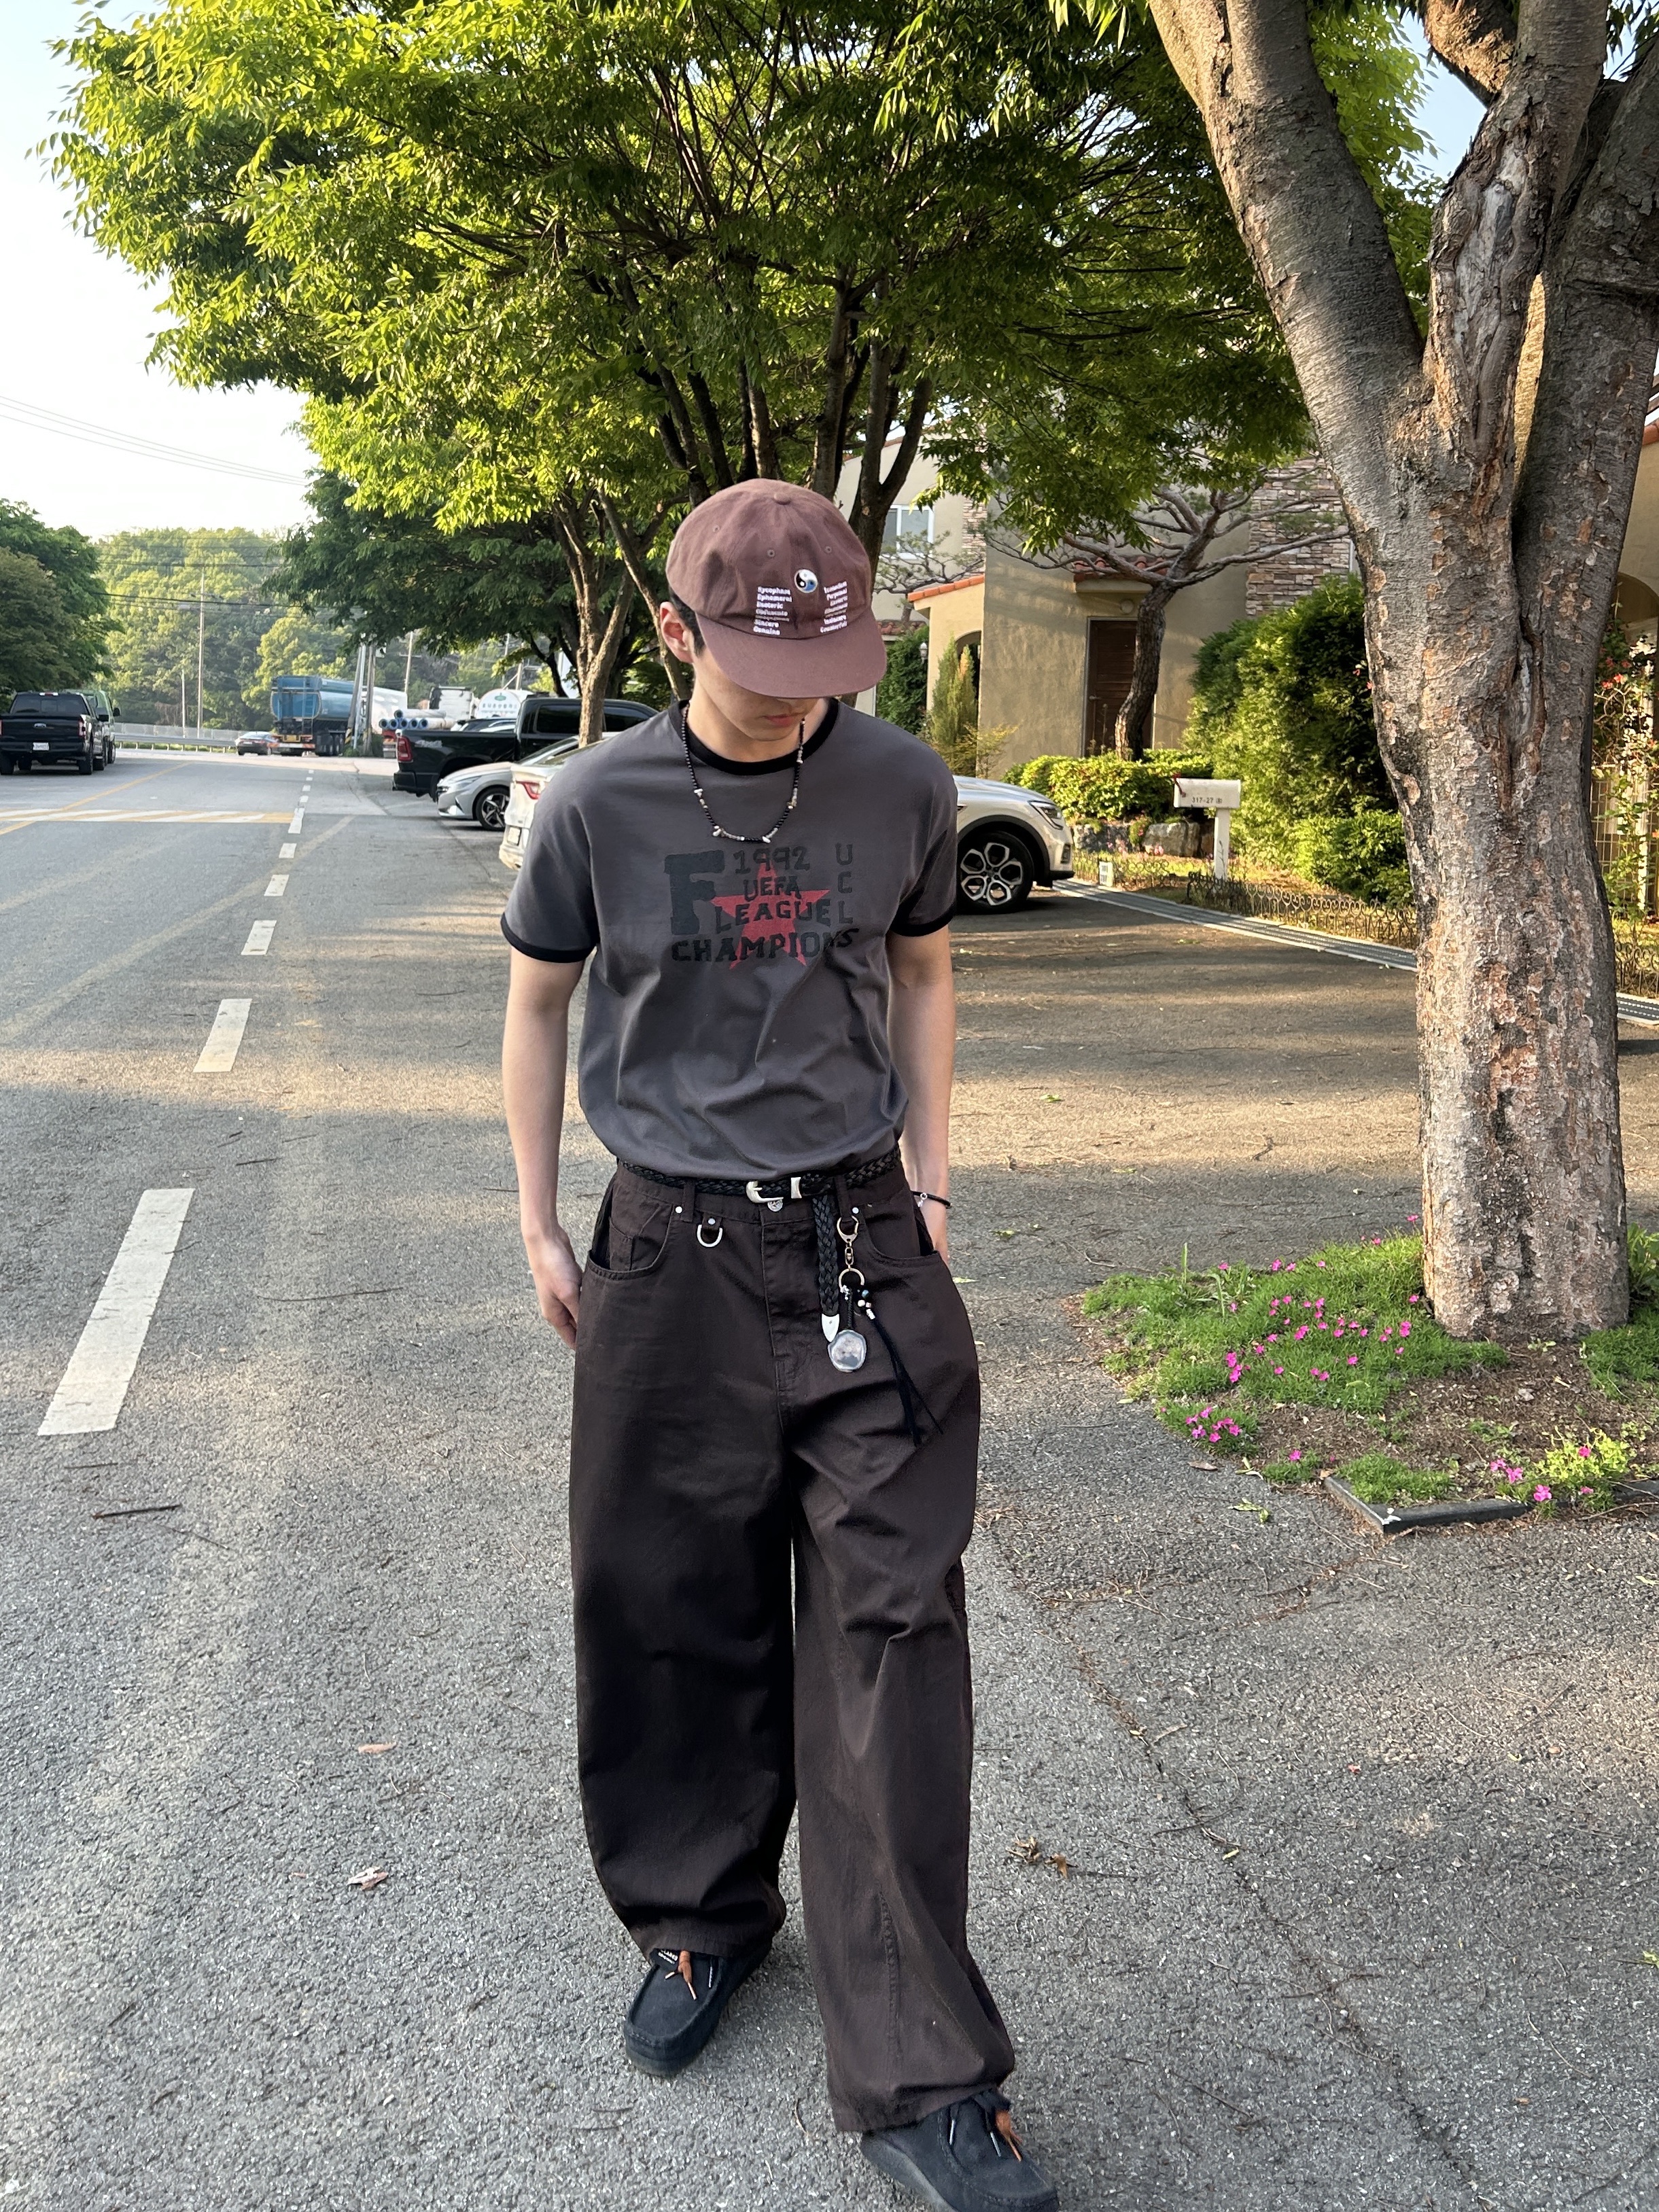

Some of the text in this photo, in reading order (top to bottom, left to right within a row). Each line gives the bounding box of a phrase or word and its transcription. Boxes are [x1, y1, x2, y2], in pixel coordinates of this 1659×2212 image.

[733, 845, 811, 875] 1992
[744, 875, 803, 902] UEFA
[715, 898, 832, 934] LEAGUE
[671, 927, 860, 962] CHAMPIONS
